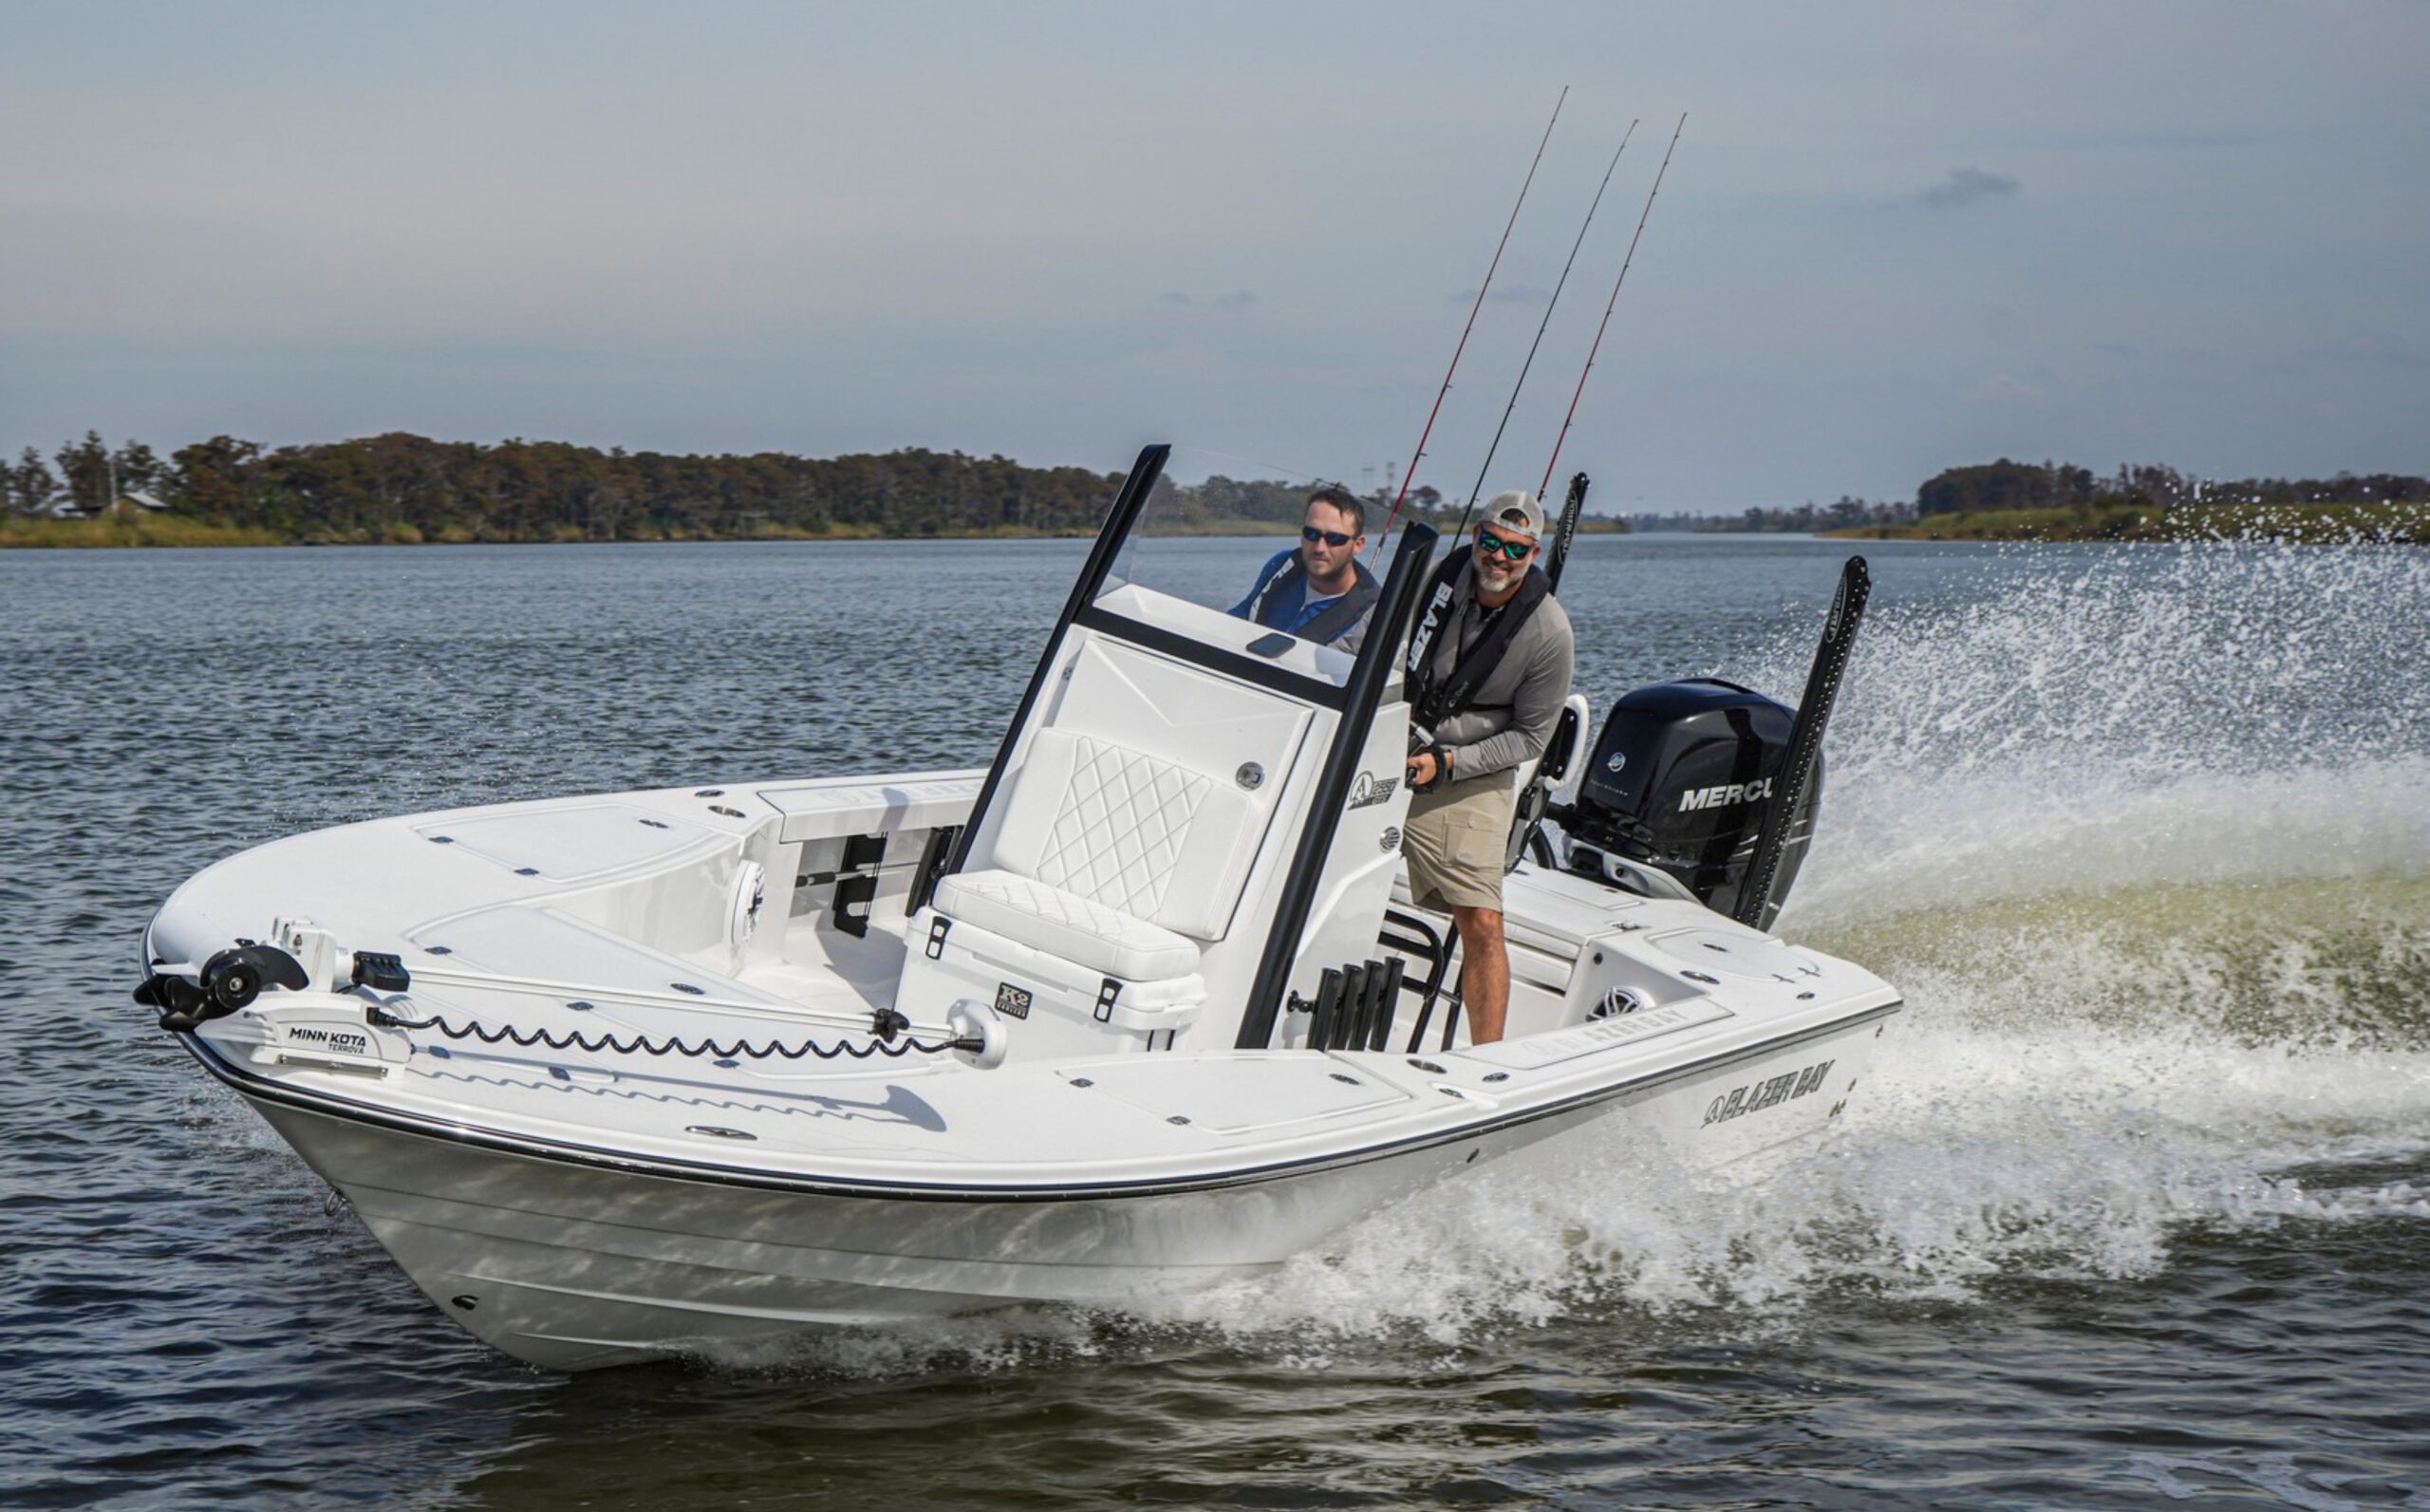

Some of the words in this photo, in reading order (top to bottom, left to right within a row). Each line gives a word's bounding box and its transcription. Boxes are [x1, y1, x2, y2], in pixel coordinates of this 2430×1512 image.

[1408, 582, 1454, 672] BLAZER
[1000, 985, 1029, 1007] K2
[290, 1028, 327, 1042] MINN
[330, 1032, 366, 1047] KOTA
[1717, 1070, 1800, 1123] BLAZER
[1791, 1058, 1836, 1099] BAY
